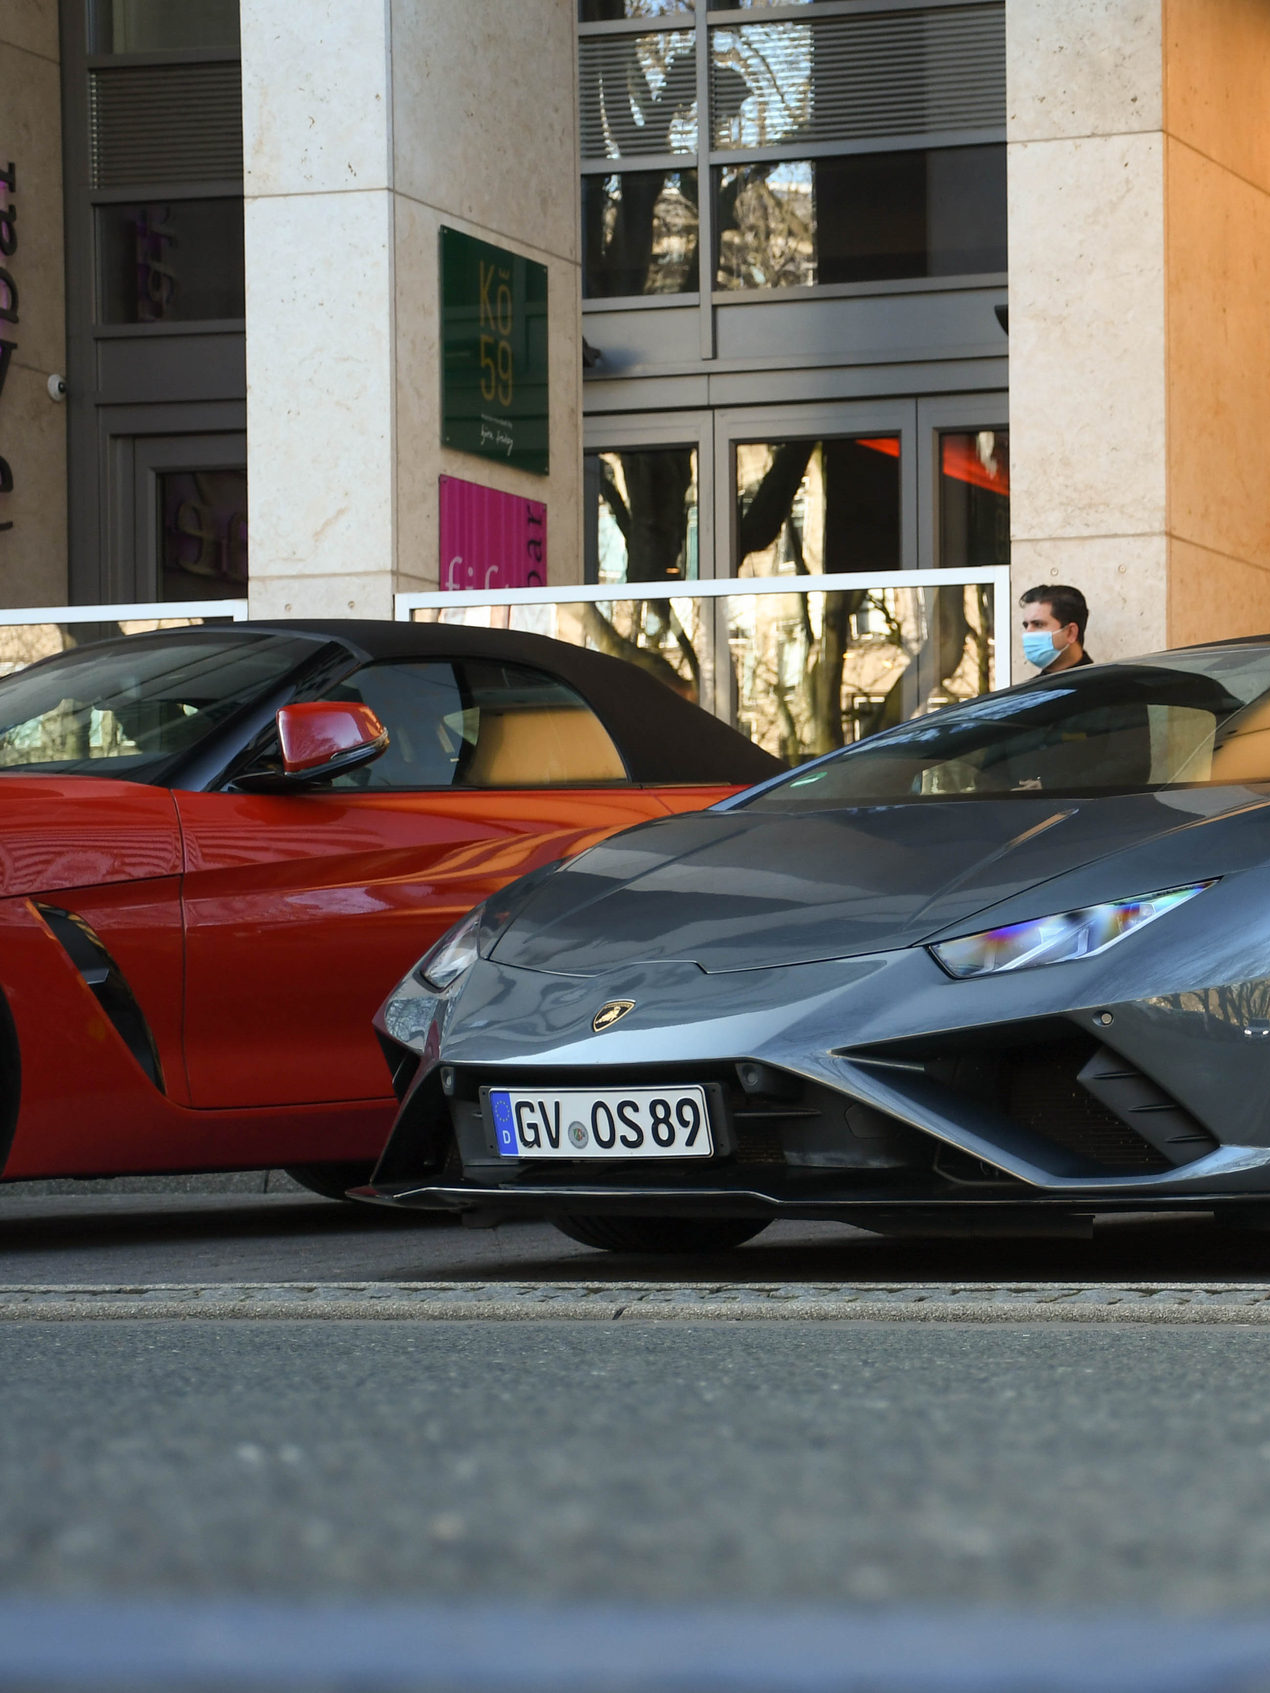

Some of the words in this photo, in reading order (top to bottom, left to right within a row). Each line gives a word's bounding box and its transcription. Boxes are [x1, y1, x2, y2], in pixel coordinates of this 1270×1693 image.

[480, 334, 513, 407] 59
[502, 1130, 512, 1145] D
[515, 1099, 561, 1149] GV
